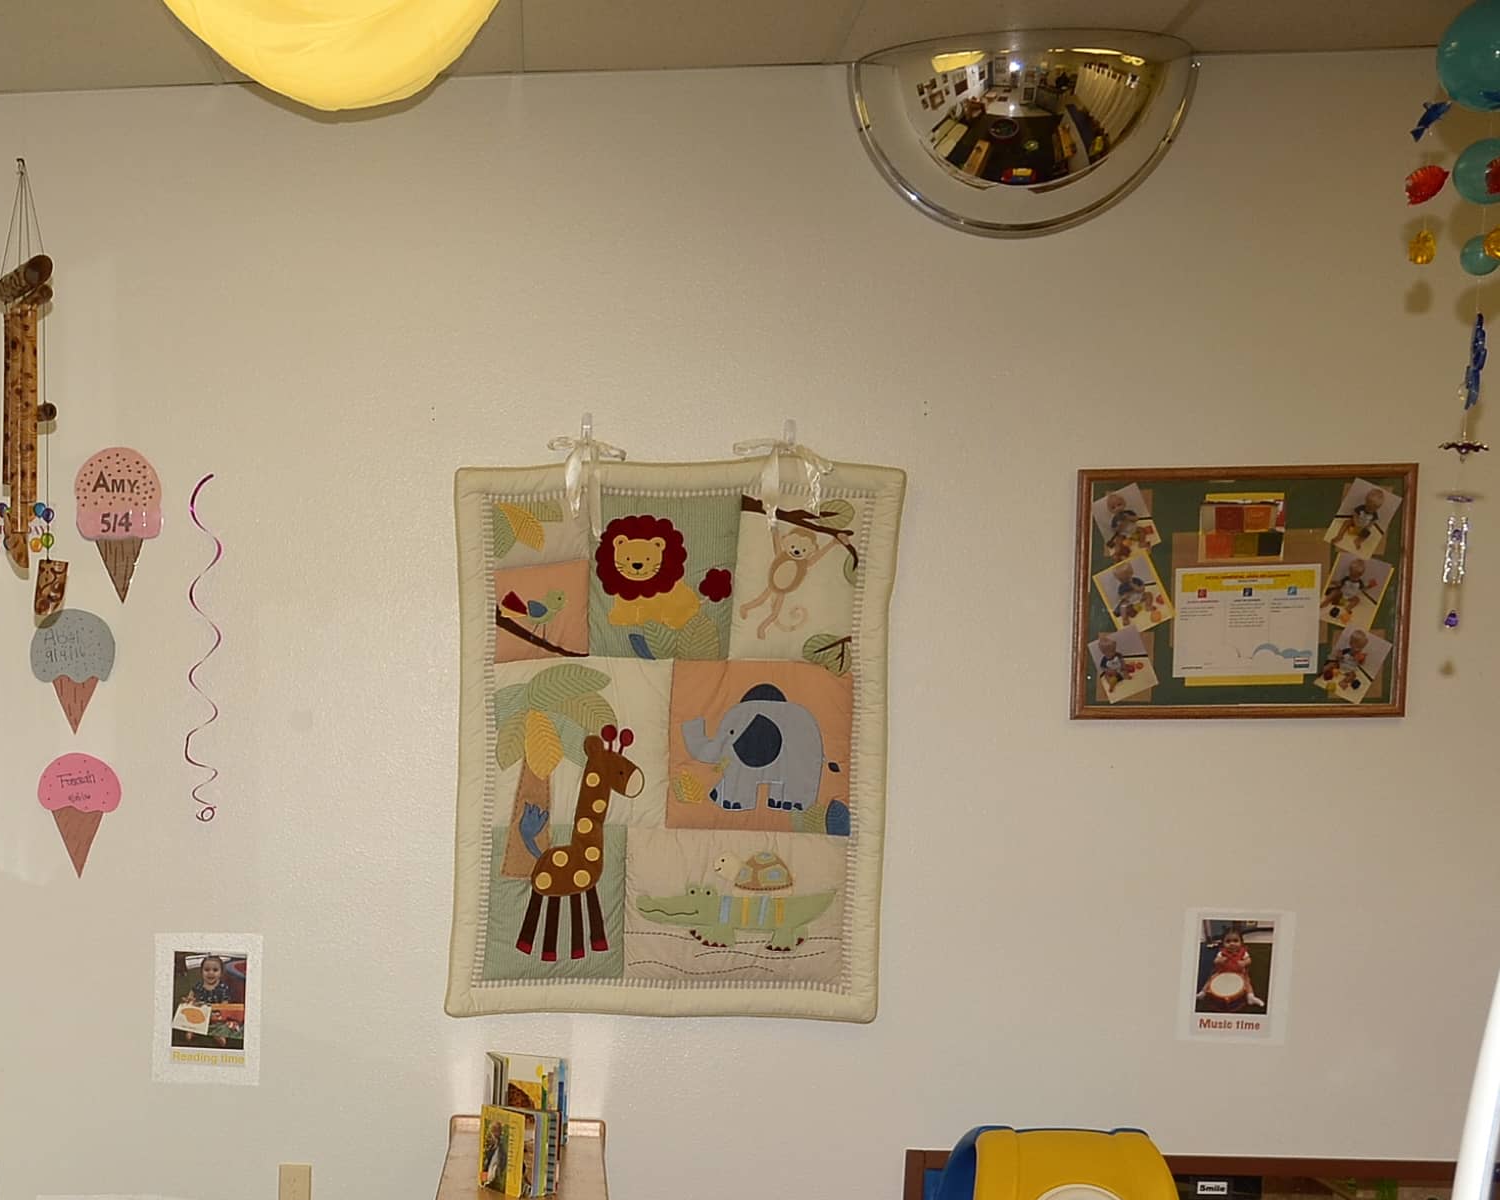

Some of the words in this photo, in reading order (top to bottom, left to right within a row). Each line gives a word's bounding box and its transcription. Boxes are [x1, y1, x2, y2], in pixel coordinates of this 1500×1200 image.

[100, 511, 132, 533] 5/4
[1198, 1018, 1233, 1029] Music
[1236, 1020, 1261, 1031] time
[172, 1051, 218, 1066] Reading
[221, 1053, 245, 1064] time
[1199, 1184, 1226, 1192] Smile
